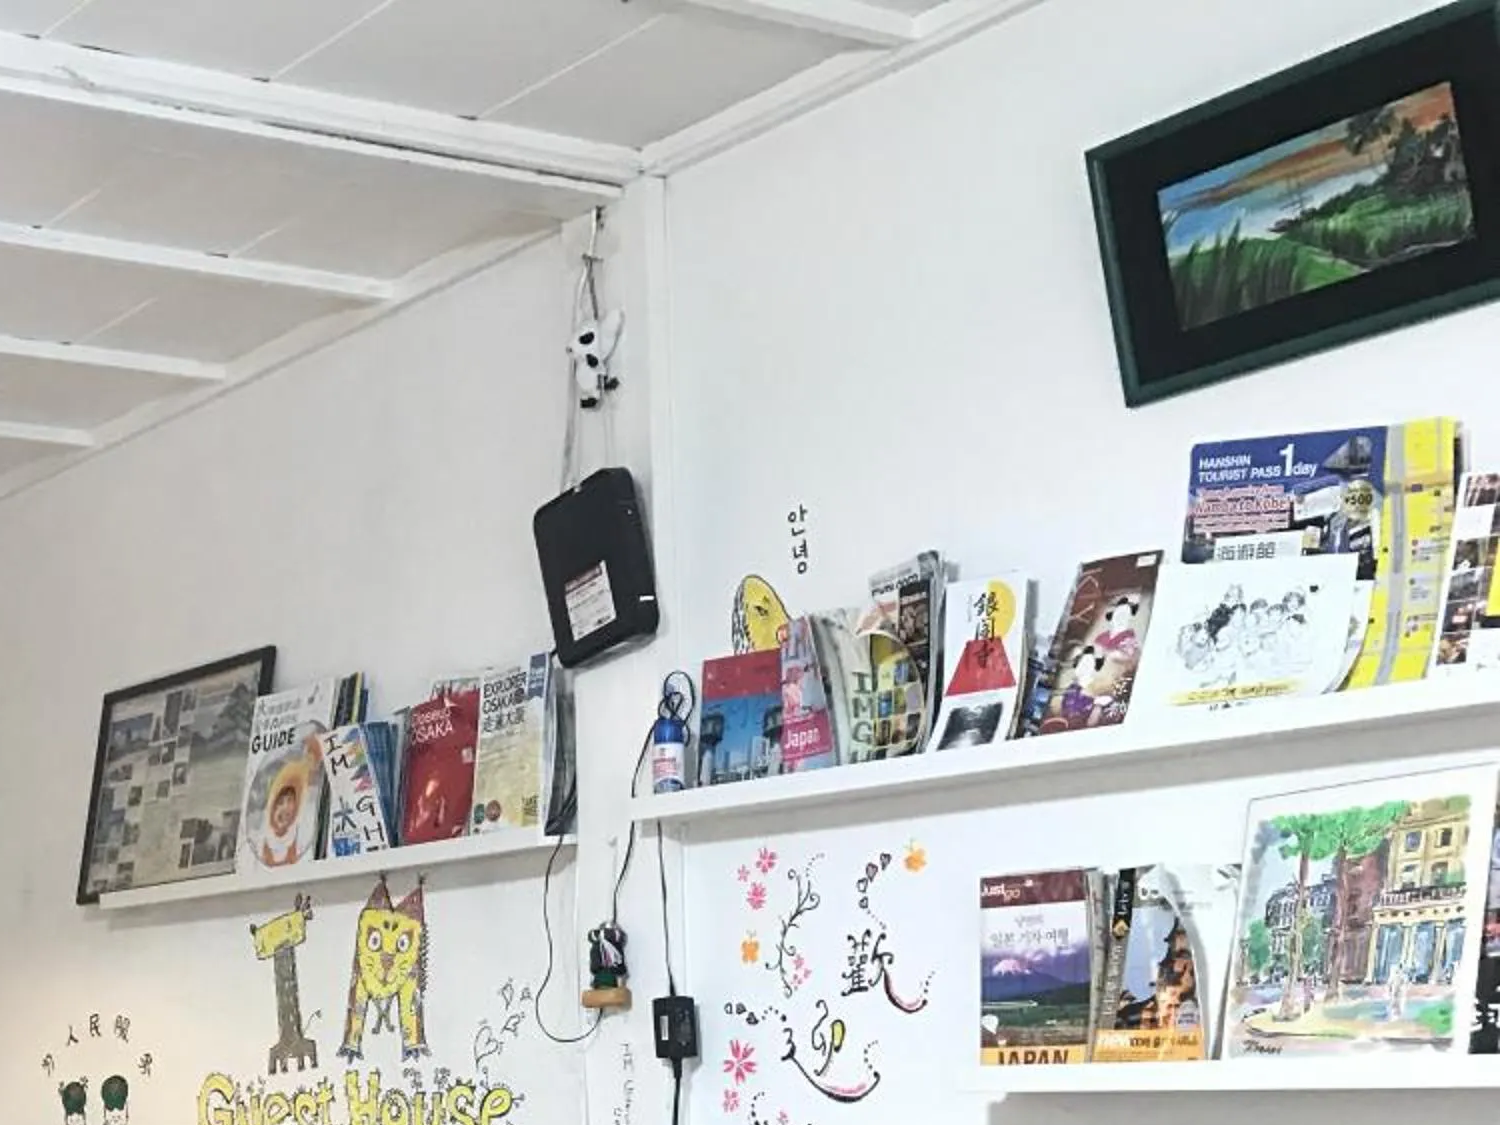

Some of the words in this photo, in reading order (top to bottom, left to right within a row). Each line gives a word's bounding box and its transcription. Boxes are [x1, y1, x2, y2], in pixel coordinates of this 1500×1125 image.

[1198, 467, 1248, 482] TOURIST
[1250, 464, 1282, 480] PASS
[1199, 454, 1251, 470] HANSHIN
[787, 503, 809, 574] 안녕
[251, 727, 296, 755] GUIDE
